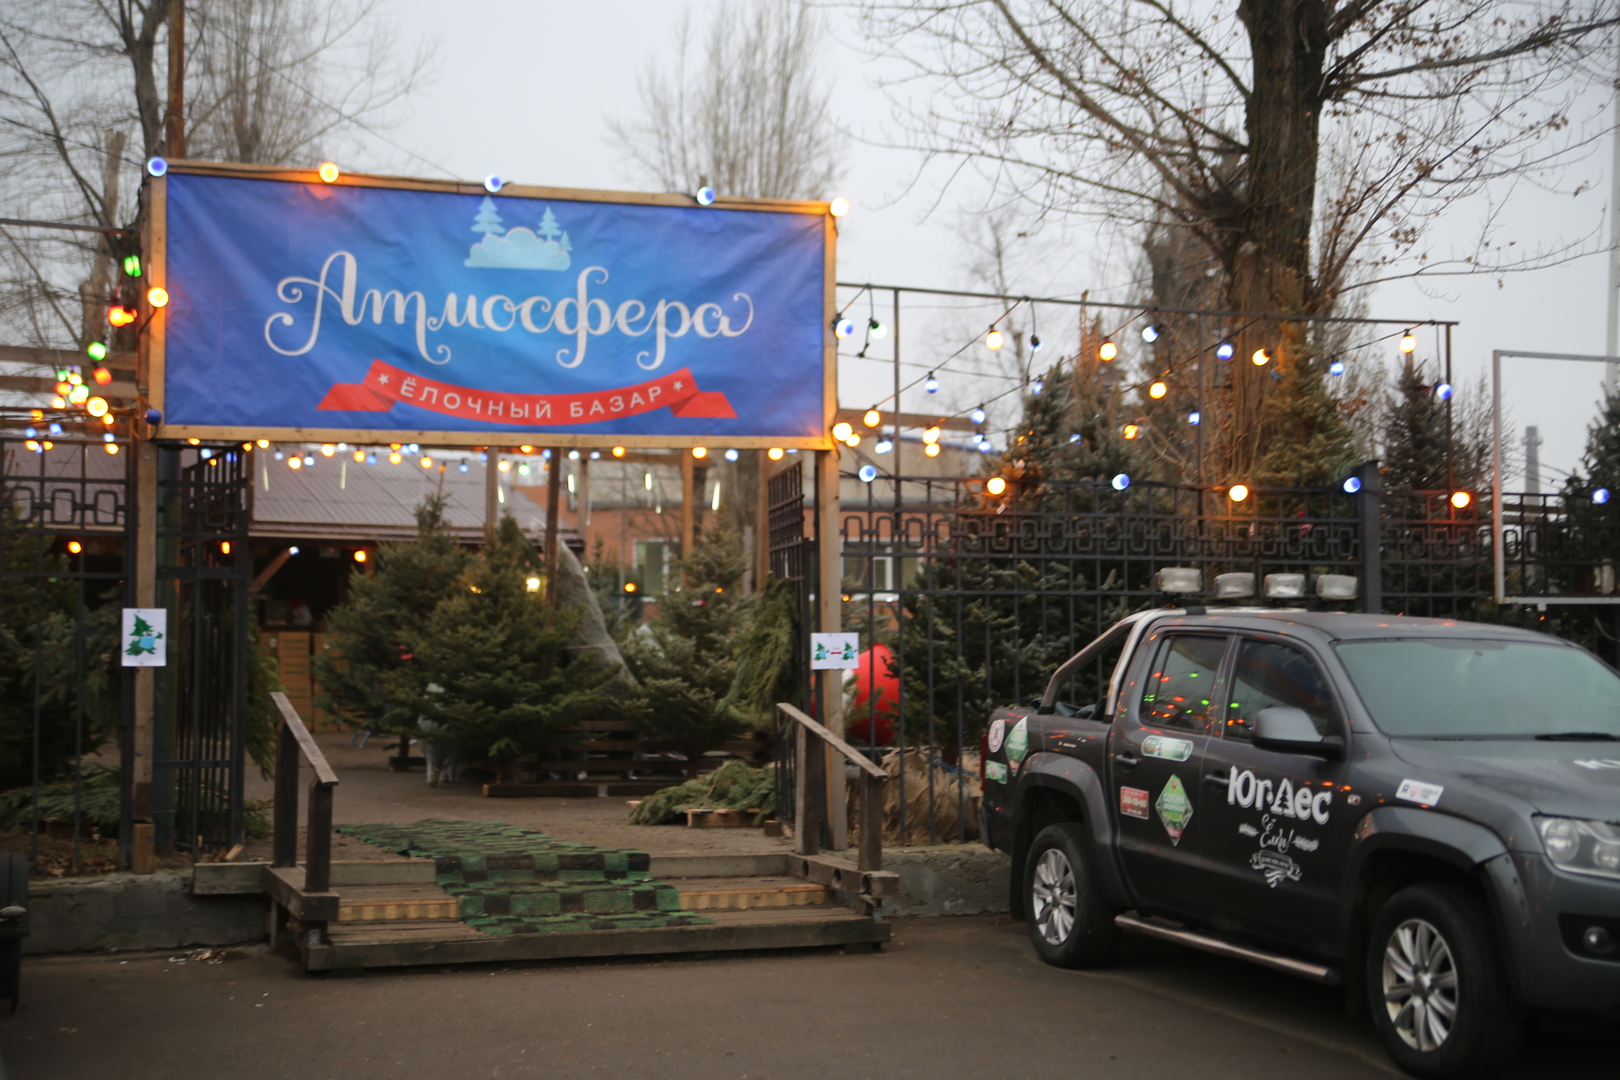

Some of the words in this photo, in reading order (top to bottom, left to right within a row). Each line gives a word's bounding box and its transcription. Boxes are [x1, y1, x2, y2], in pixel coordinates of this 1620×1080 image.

[264, 250, 755, 371] Атмосфера
[400, 377, 552, 419] ЁЛОЧНЫЙ
[569, 386, 662, 418] БАЗАР
